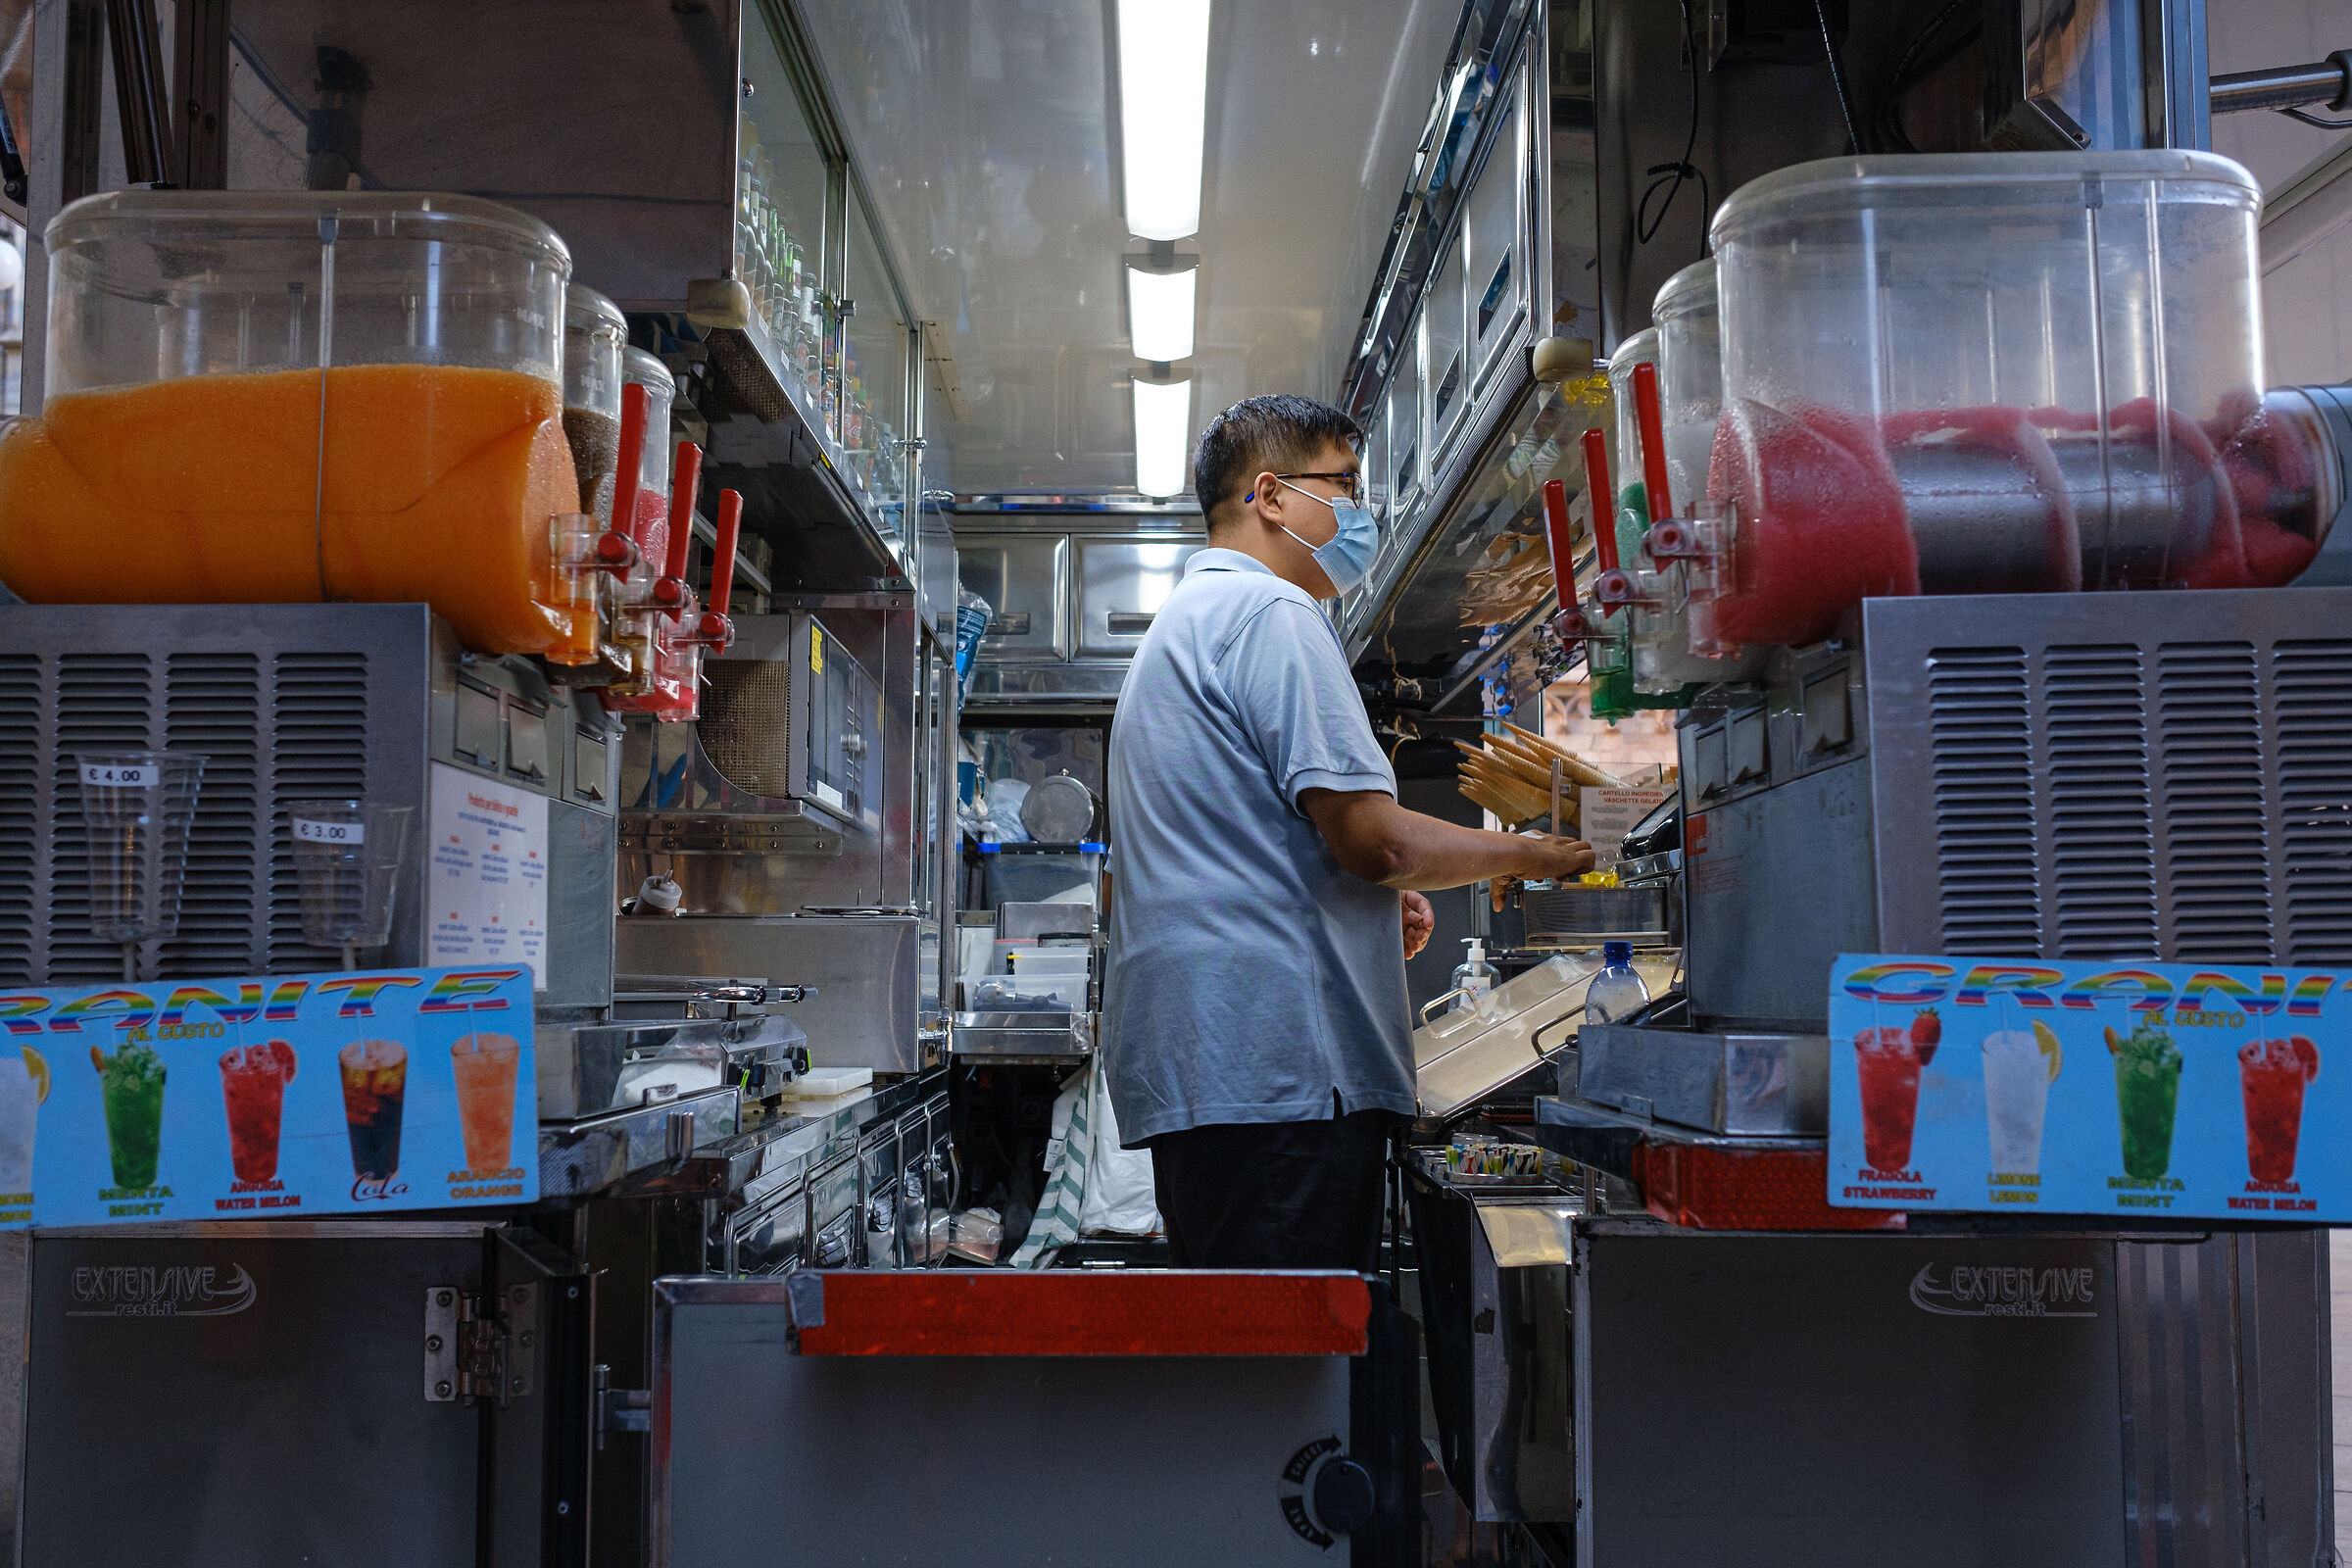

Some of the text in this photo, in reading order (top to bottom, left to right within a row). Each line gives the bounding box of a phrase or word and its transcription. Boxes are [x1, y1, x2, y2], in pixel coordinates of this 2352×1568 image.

[105, 769, 140, 782] 4.00
[315, 825, 346, 839] 3.00
[1843, 962, 2352, 1018] GRANI
[2142, 1010, 2245, 1028] AL GUSTO
[126, 1022, 225, 1042] AL GUSTO
[447, 1167, 525, 1184] ARANCIO
[1858, 1169, 1923, 1183] FRAGOLA
[1986, 1172, 2041, 1187] LIMONE
[229, 1179, 285, 1194] ANGURIA
[350, 1172, 409, 1202] Cola
[451, 1184, 523, 1200] ORANGE
[2108, 1176, 2185, 1192] MENTA
[2244, 1180, 2301, 1194] ANGURIA
[98, 1185, 173, 1201] MENTA
[1842, 1186, 1936, 1200] STRAWBERRY
[1989, 1189, 2038, 1203] LEMON
[2117, 1194, 2175, 1207] MINT
[108, 1202, 165, 1217] MINT
[215, 1195, 301, 1211] WATER MELON
[2228, 1197, 2317, 1211] WATER MELON
[72, 1266, 217, 1301] EXTENSIVE
[1951, 1266, 2093, 1301] EXTENSIVE
[115, 1300, 178, 1317] resti.it
[1984, 1301, 2047, 1317] resti.it
